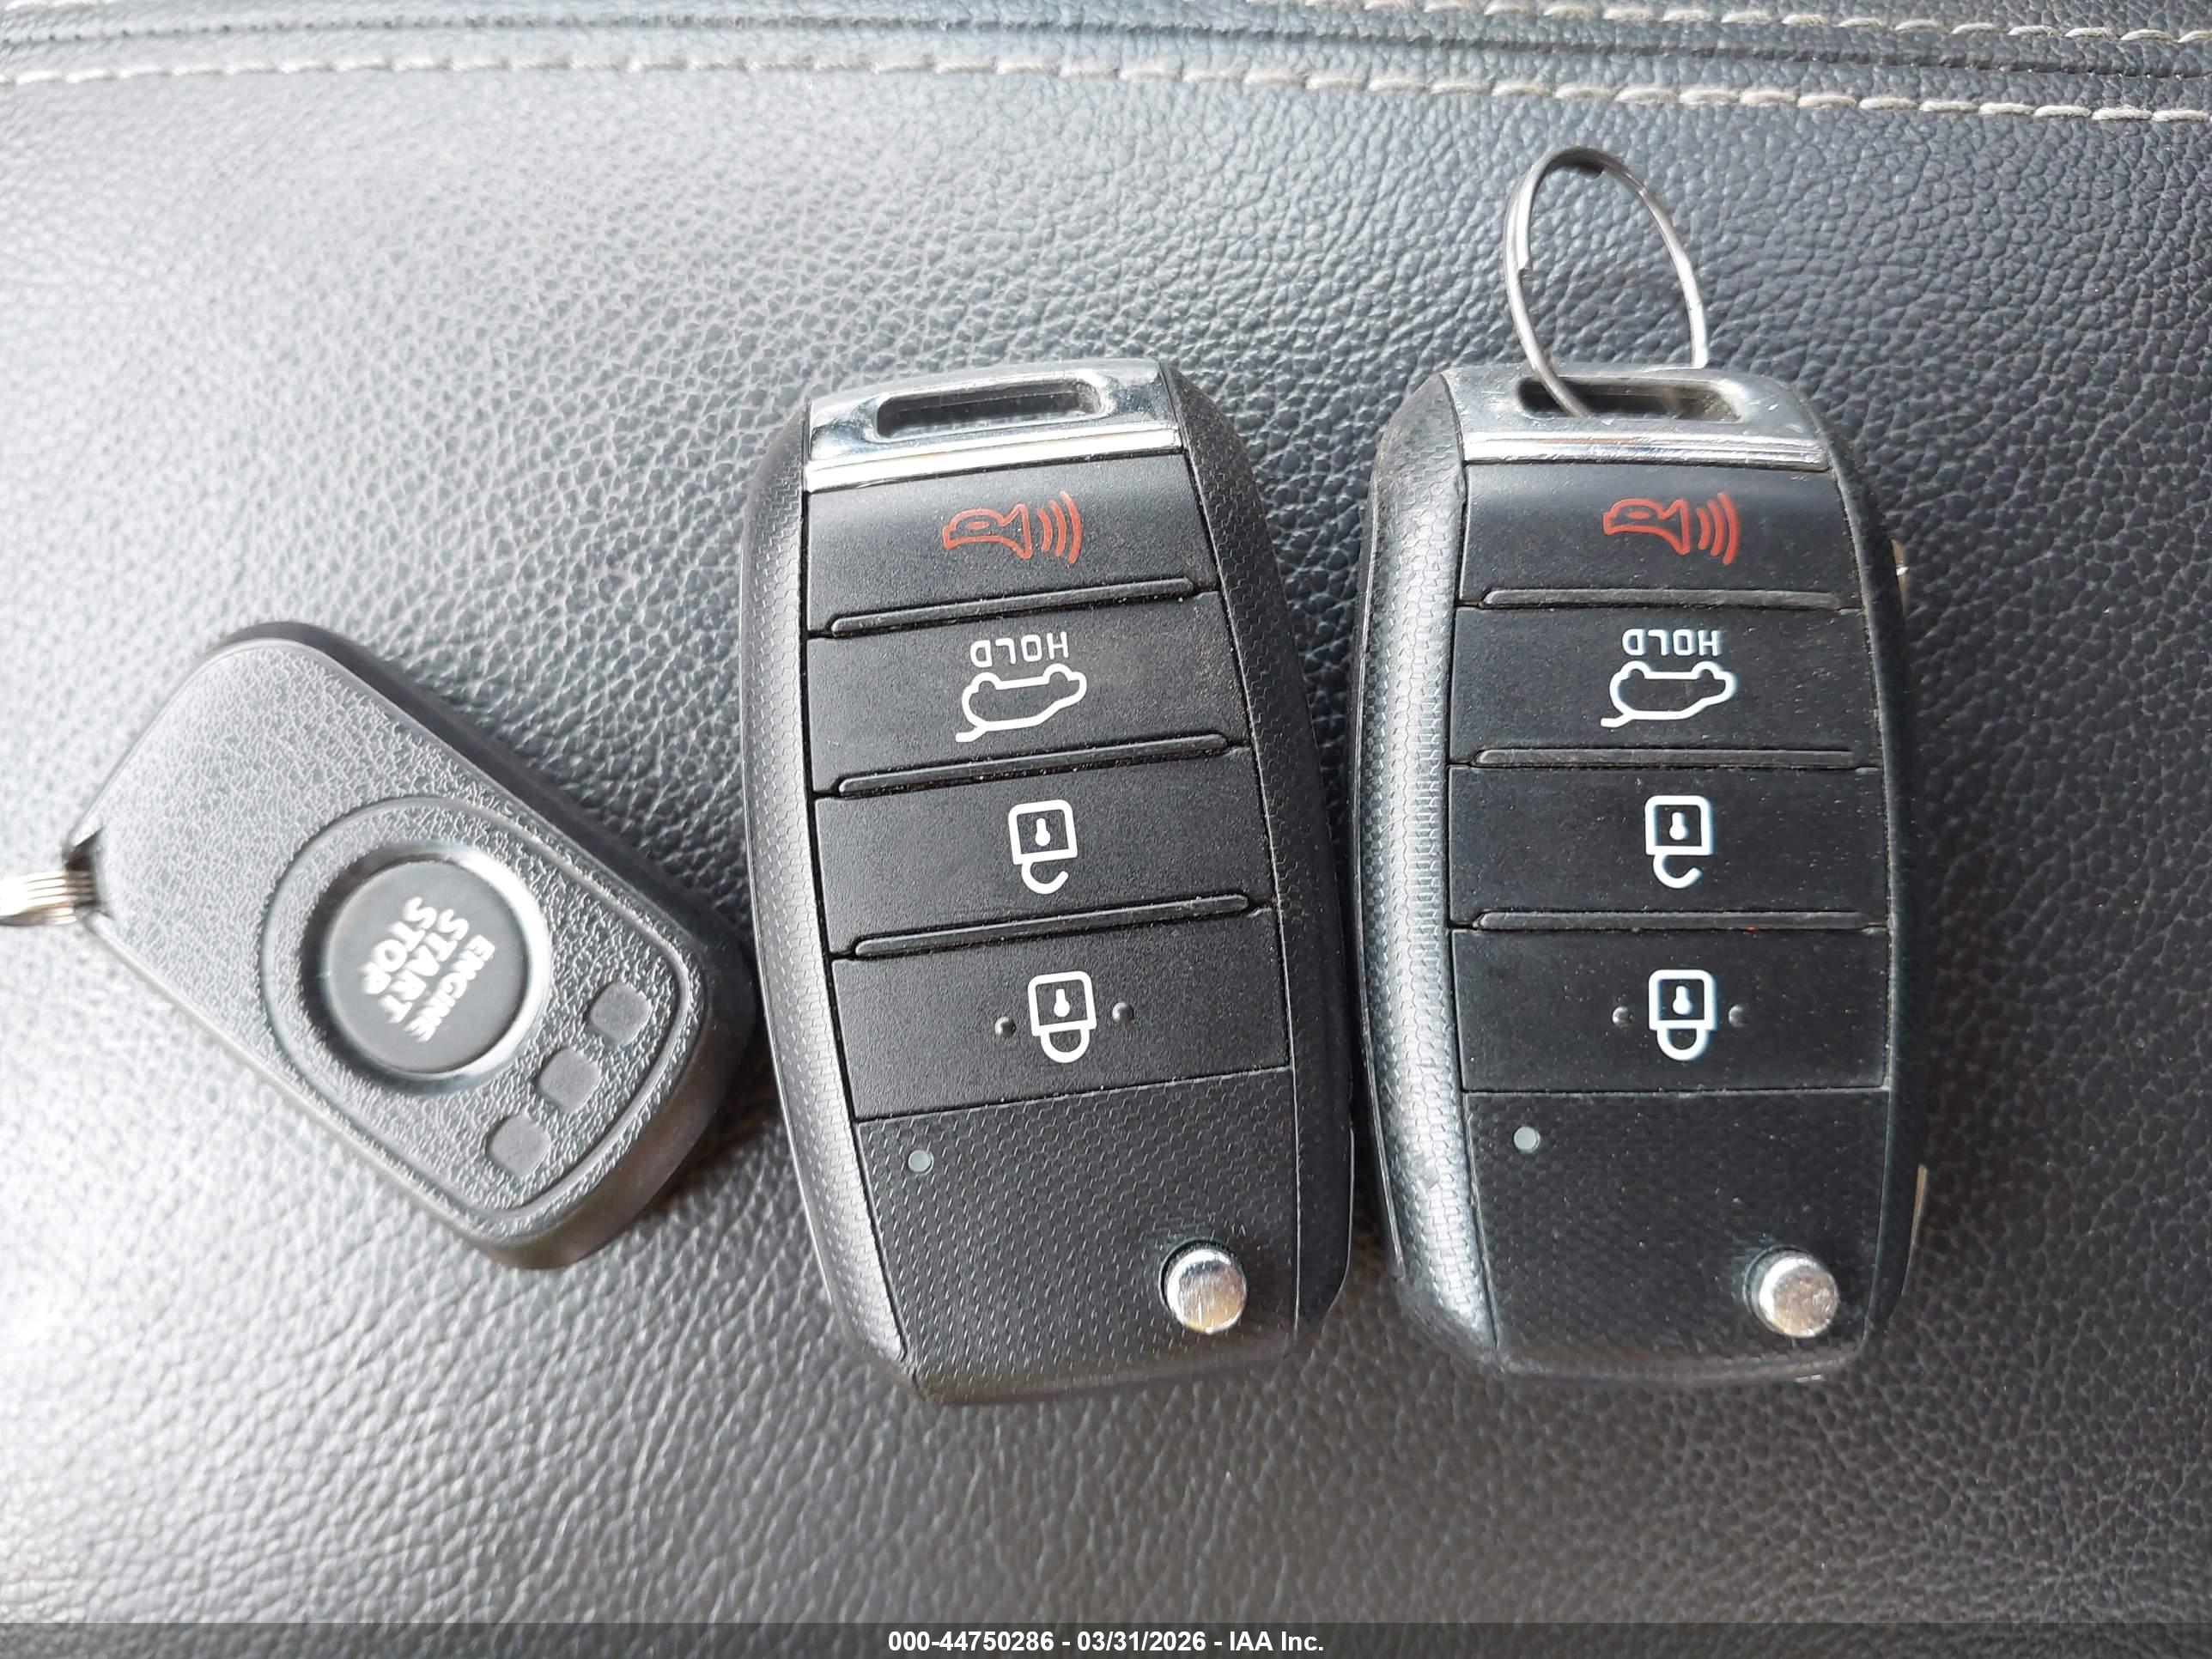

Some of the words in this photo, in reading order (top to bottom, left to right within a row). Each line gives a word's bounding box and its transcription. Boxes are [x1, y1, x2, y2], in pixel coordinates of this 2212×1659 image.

[969, 631, 1069, 668] HOLD
[1622, 628, 1723, 656] HOLD
[360, 896, 437, 995] STOP
[378, 908, 470, 1024] START
[404, 934, 496, 1043] ENGINE
